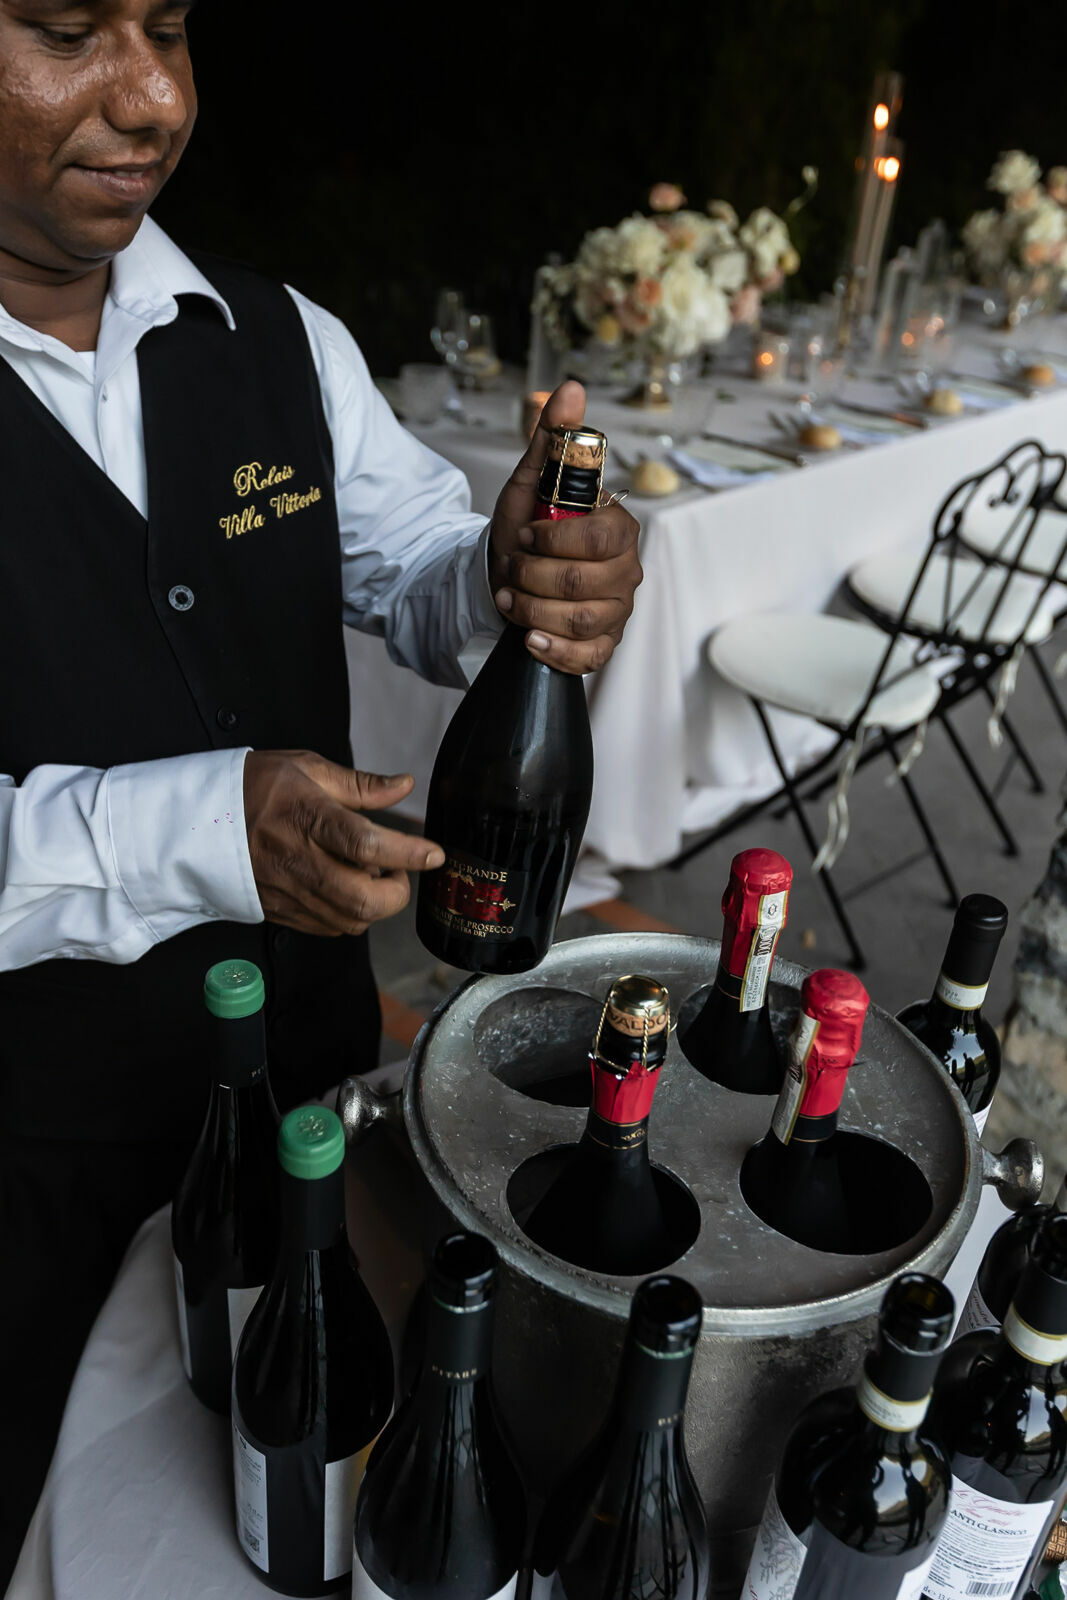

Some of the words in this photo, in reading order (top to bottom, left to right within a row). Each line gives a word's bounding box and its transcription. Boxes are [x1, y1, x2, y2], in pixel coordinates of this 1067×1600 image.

[233, 461, 295, 496] Relais
[219, 505, 266, 539] Villa
[269, 486, 322, 518] Vittoria
[467, 920, 514, 934] PROSECCO
[473, 929, 486, 938] DRY
[951, 1508, 976, 1526] ANTI
[977, 1524, 1028, 1536] CLASSICO
